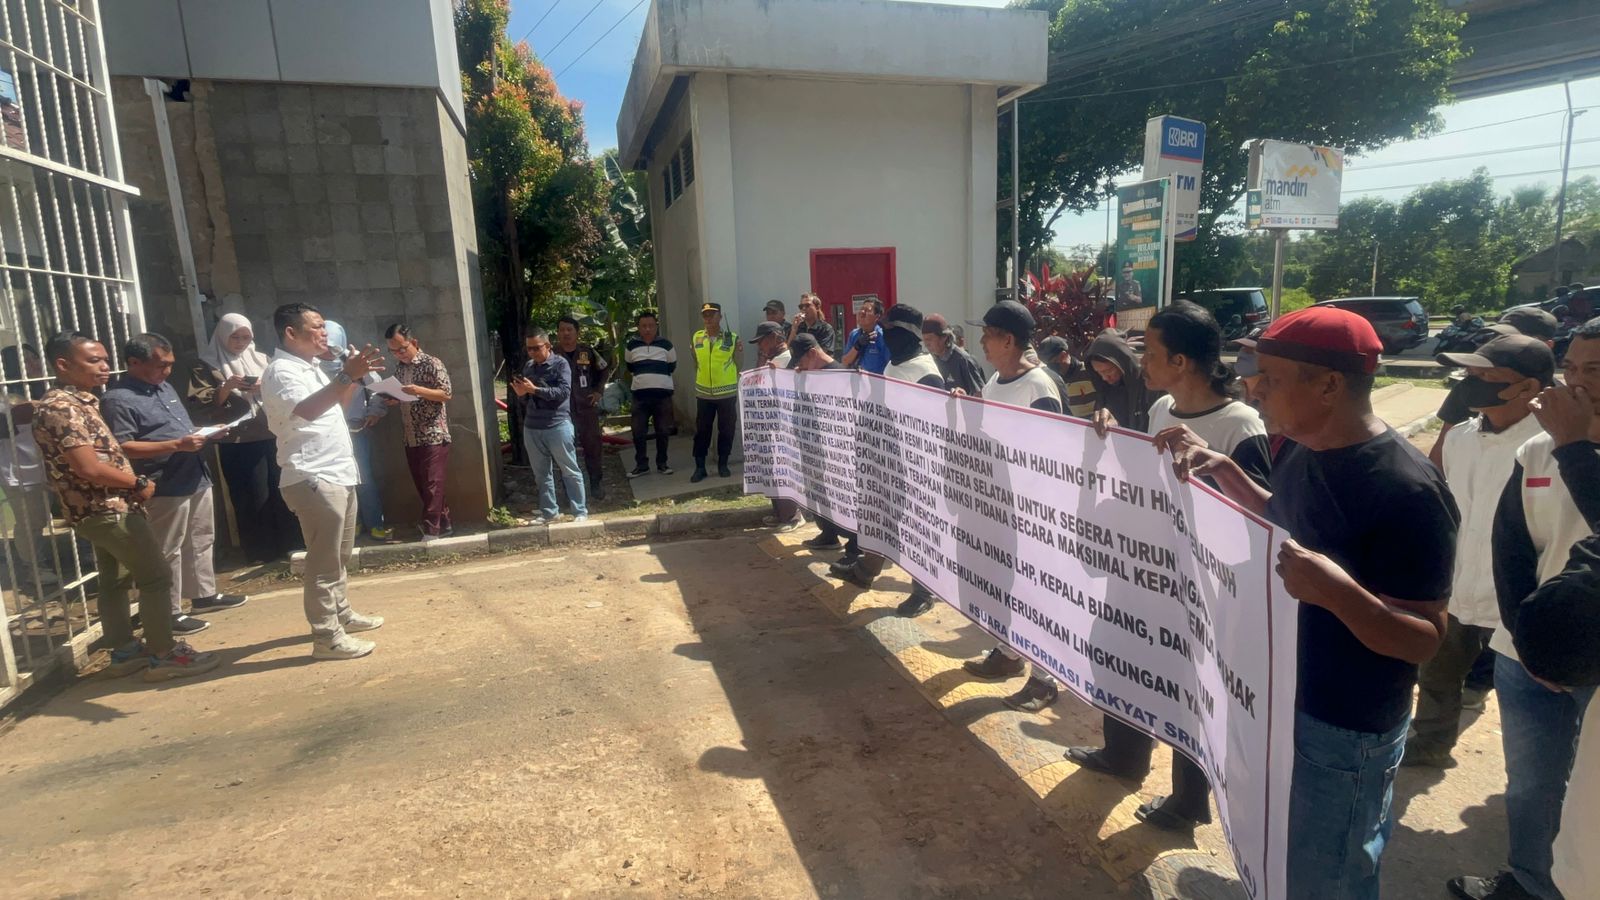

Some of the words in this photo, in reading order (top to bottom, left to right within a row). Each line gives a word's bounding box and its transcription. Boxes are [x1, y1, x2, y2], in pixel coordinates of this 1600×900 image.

[1180, 130, 1198, 148] BRI
[1176, 174, 1196, 191] TM
[1265, 176, 1308, 197] mandiri
[899, 412, 930, 435] AKTIVITAS
[931, 423, 992, 457] PEMBANGUNAN
[994, 444, 1027, 470] JALAN
[1030, 454, 1085, 487] HAULING
[1088, 471, 1107, 494] PT
[1111, 477, 1145, 507] LEVI
[904, 432, 923, 451] RESMI
[924, 439, 938, 457] DAN
[938, 444, 993, 478] TRANSPARAN
[892, 505, 931, 541] LINGKUNGAN
[931, 531, 941, 548] INI
[905, 450, 926, 469] KEJATI
[931, 460, 972, 491] SUMATERA
[973, 476, 1015, 507] SELATAN
[1017, 494, 1057, 525] UNTUK
[1060, 511, 1114, 549] SEGERA
[1117, 533, 1176, 573] TURUN
[909, 468, 942, 496] TERAPKAN
[943, 484, 973, 509] SANKSI
[975, 498, 1009, 527] PIDANA
[1011, 513, 1055, 548] SECARA
[1057, 534, 1130, 582] MAKSIMAL
[864, 525, 883, 541] DARI
[907, 544, 928, 572] ILEGAL
[929, 562, 939, 580] INI
[892, 491, 914, 512] UNTUK
[914, 503, 949, 535] MENCOPOT
[950, 525, 982, 555] KEPALA
[984, 541, 1013, 569] DINAS
[1015, 557, 1038, 586] LHP,
[1040, 570, 1086, 610] KEPALA
[1088, 596, 1154, 646] BIDANG,
[900, 527, 922, 550] PENUH
[922, 541, 946, 567] UNTUK
[946, 557, 1002, 603] MEMULIHKAN
[1004, 592, 1070, 645] KERUSAKAN
[1073, 634, 1180, 704] LINGKUNGAN
[968, 603, 1009, 639] #SUARA
[1011, 629, 1081, 687] INFORMASI
[1084, 680, 1158, 727] RAKYAT
